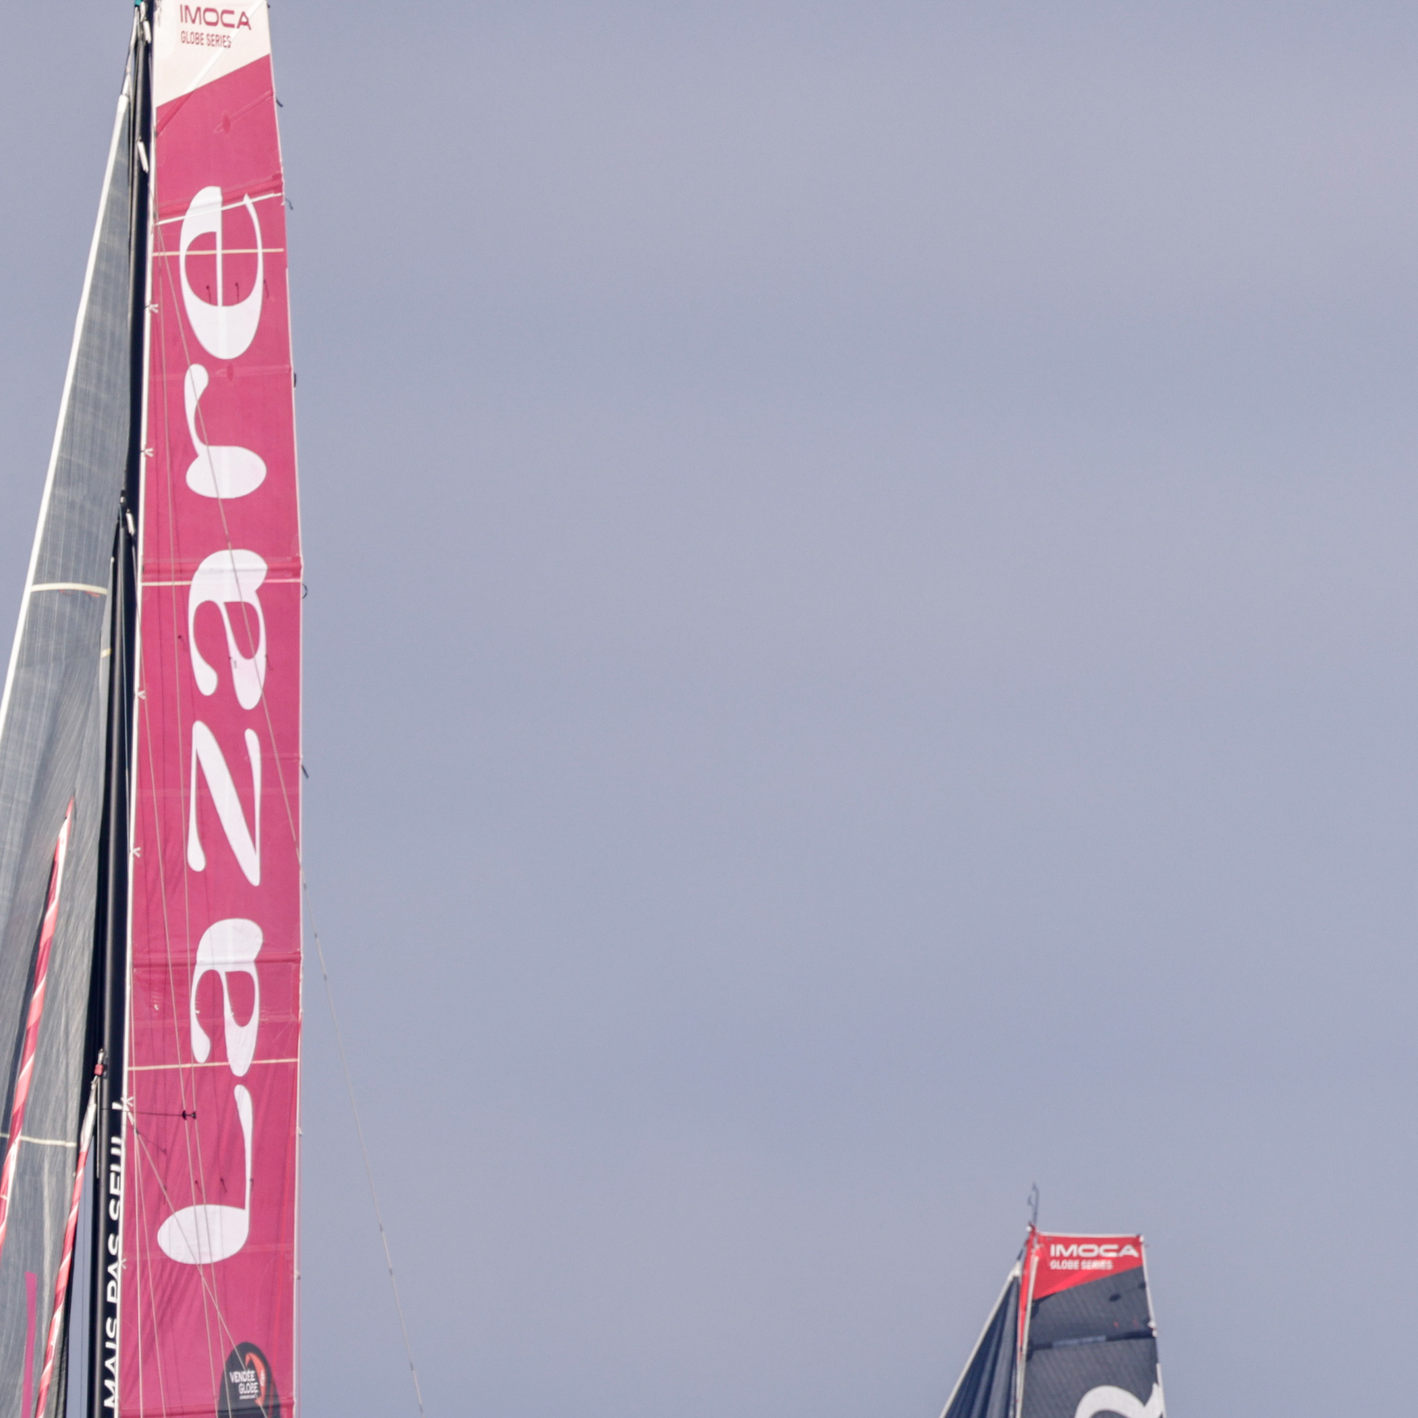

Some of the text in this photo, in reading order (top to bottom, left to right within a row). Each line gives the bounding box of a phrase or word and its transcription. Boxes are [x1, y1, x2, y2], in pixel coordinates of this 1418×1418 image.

[179, 4, 252, 31] IMOCA
[181, 30, 232, 48] GLOBE SERIES
[1050, 1243, 1140, 1258] IMOCA
[1050, 1259, 1114, 1271] GLOBE SERIES
[238, 1382, 259, 1395] GLOBE
